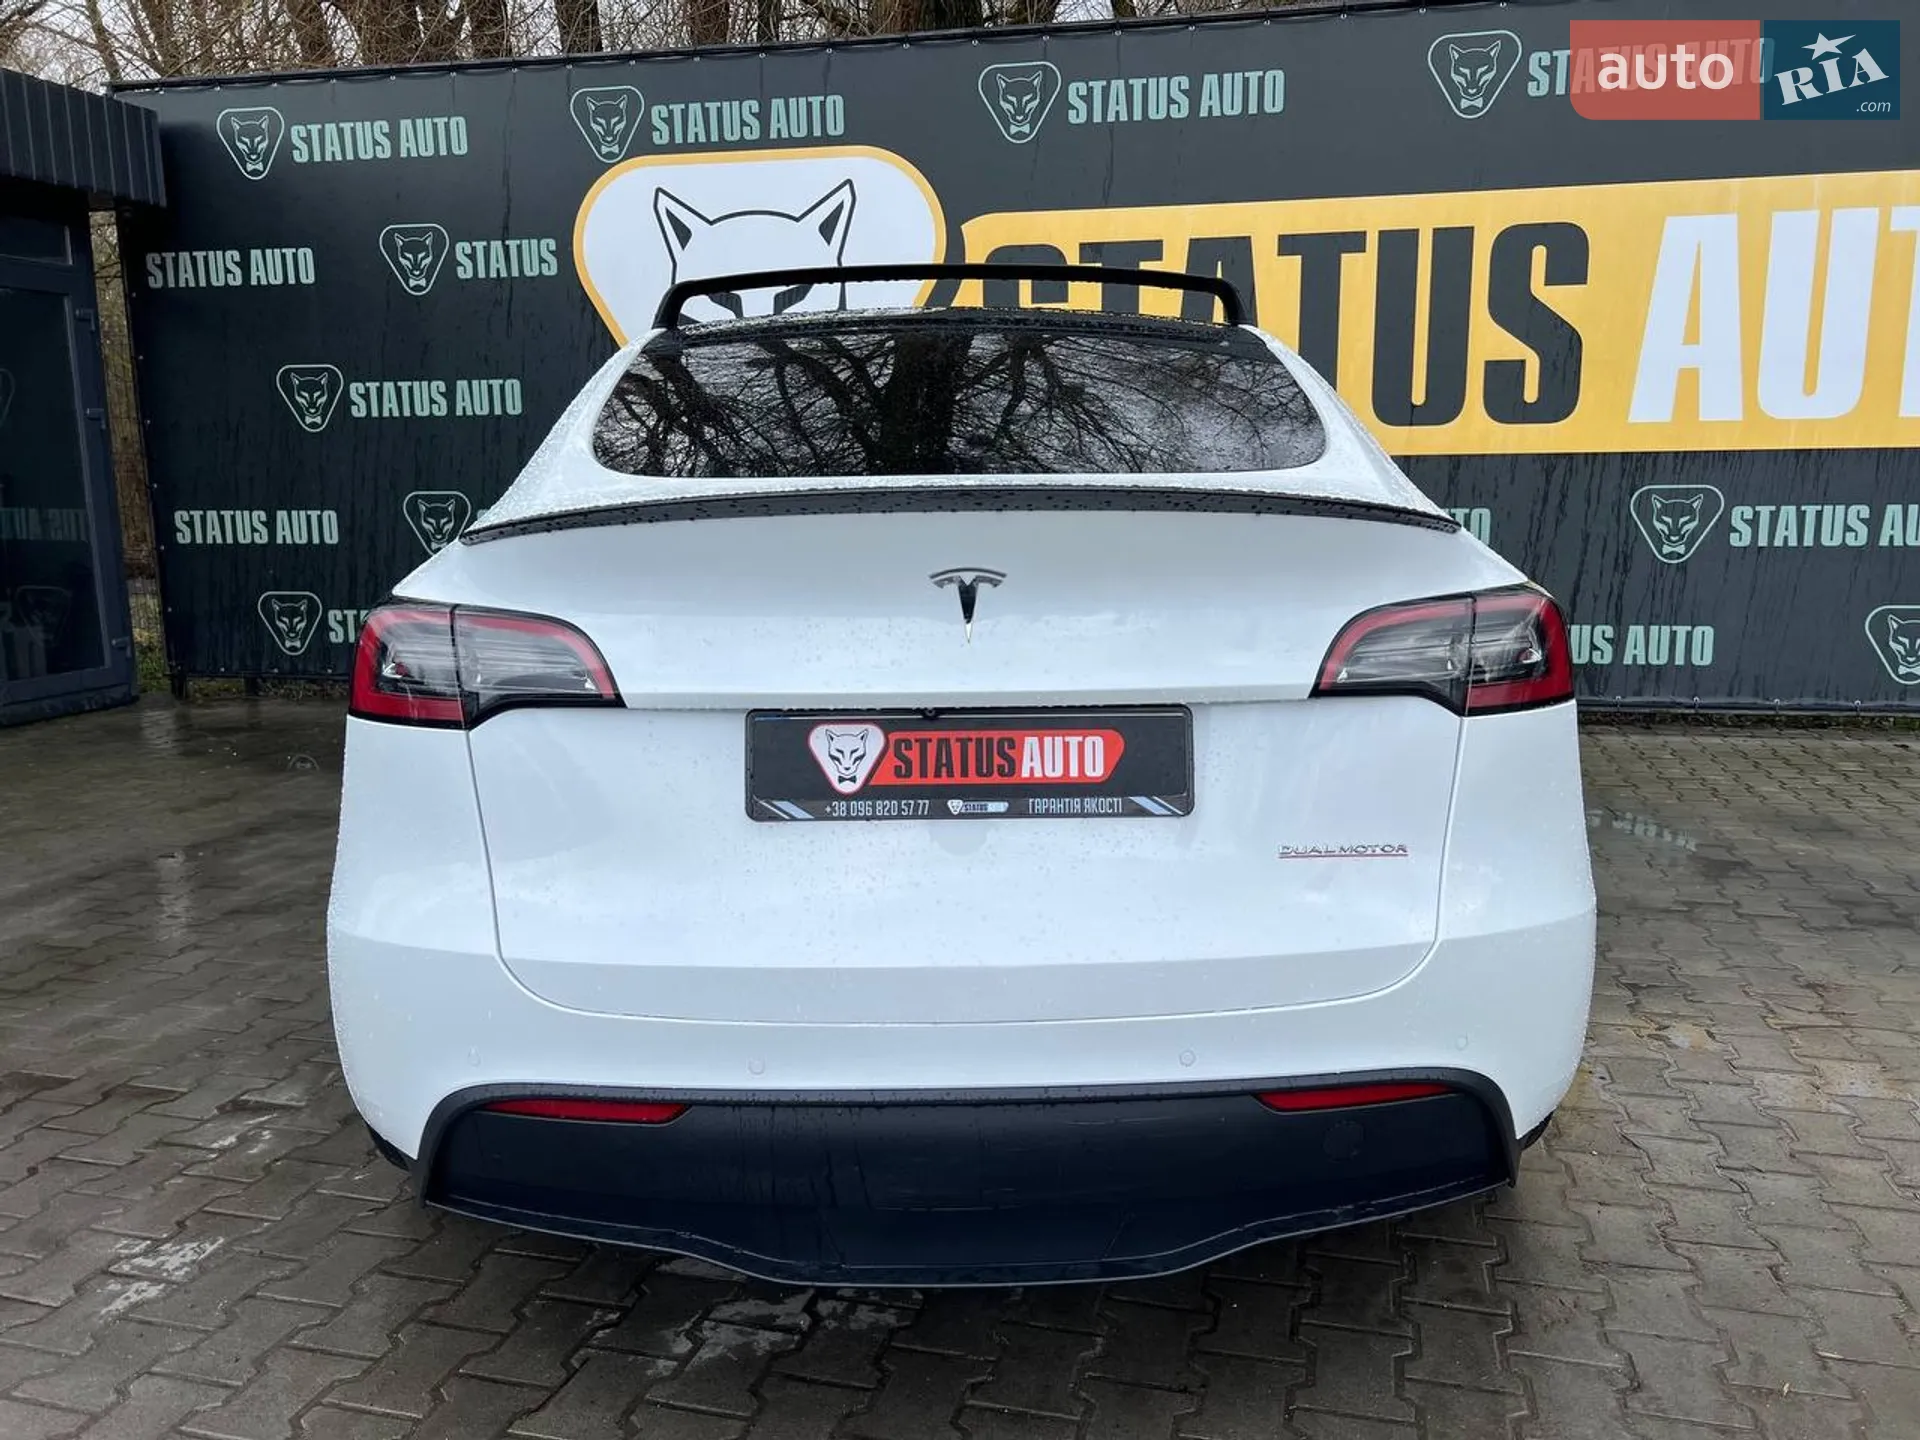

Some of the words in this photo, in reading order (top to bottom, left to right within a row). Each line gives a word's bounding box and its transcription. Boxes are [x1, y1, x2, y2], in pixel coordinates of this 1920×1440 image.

[1067, 76, 1190, 124] STATUS
[1200, 69, 1285, 118] AUTO
[290, 119, 392, 163] STATUS
[399, 116, 468, 158] AUTO
[650, 100, 760, 146] STATUS
[769, 94, 845, 140] AUTO
[147, 249, 243, 288] STATUS
[250, 247, 315, 286] AUTO
[455, 238, 558, 280] STATUS
[349, 381, 448, 418] STATUS
[455, 379, 523, 417] AUTO
[174, 510, 269, 545] STATUS
[276, 510, 339, 545] AUTO
[1729, 504, 1870, 547] STATUS
[1623, 625, 1715, 665] AUTO
[825, 801, 847, 817] +38
[850, 801, 873, 817] 096
[876, 800, 899, 816] 820
[1084, 797, 1123, 814] ЯКОСТІ
[1278, 845, 1336, 855] DUAL
[1340, 844, 1408, 853] MOTOR
